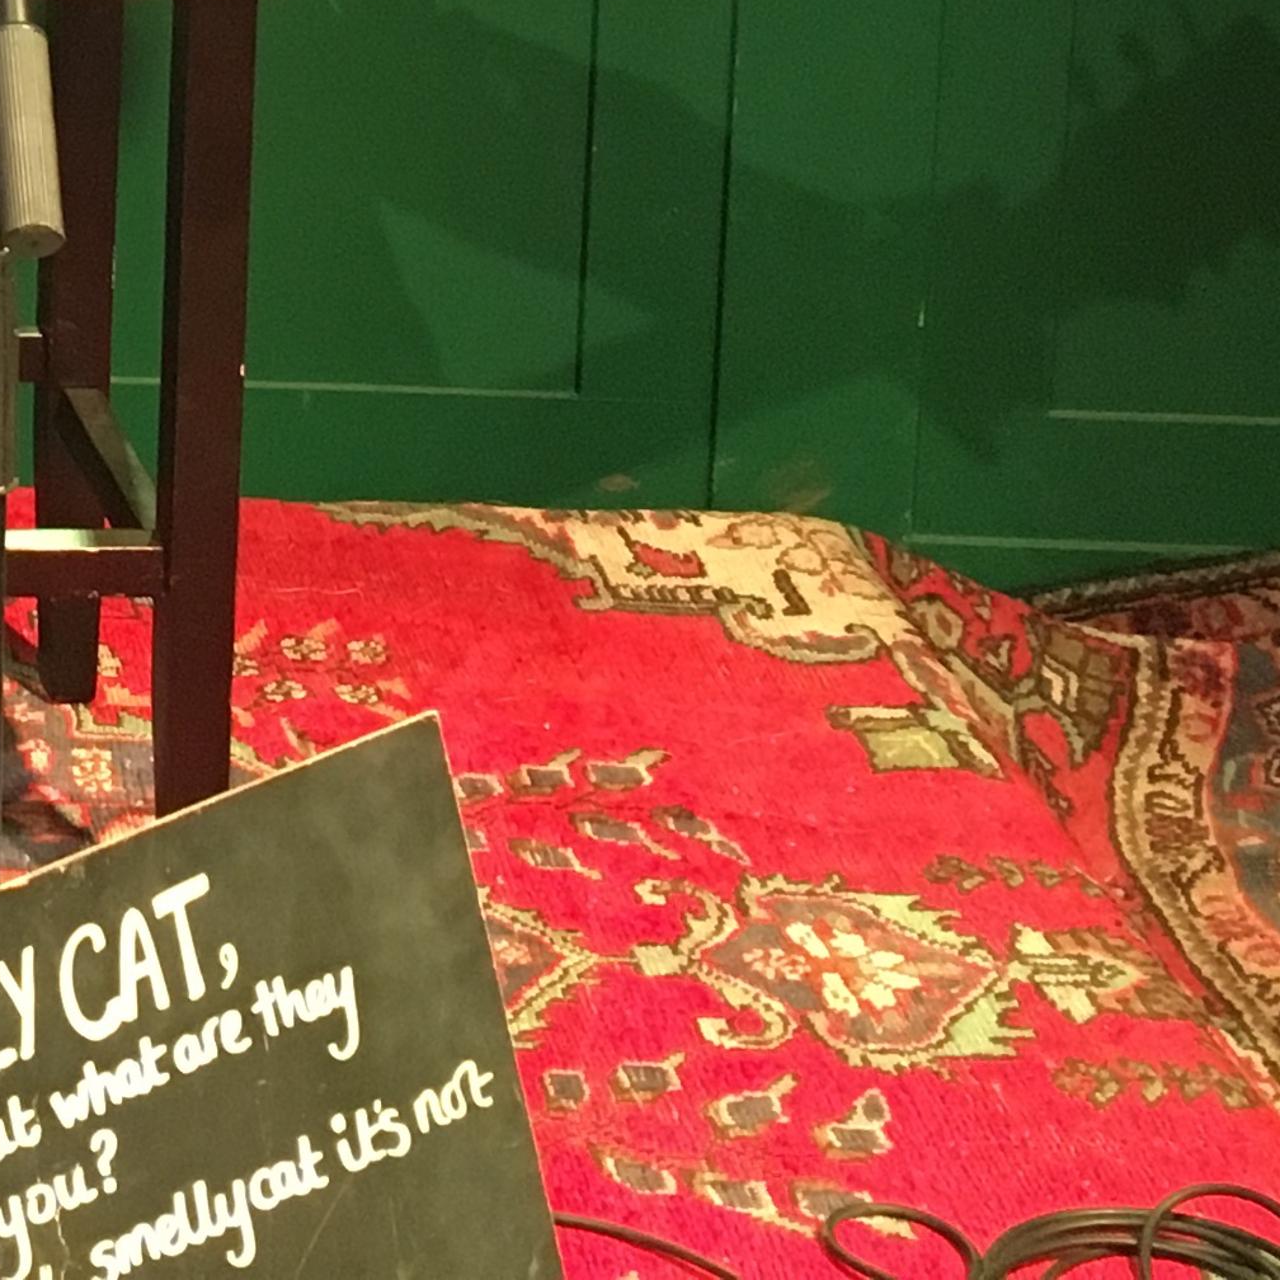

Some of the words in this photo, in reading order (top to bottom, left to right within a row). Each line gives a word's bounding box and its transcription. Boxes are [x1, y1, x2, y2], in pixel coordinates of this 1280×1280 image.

[59, 873, 239, 1042] CAT,
[49, 1036, 170, 1129] what
[173, 1009, 252, 1074] are
[251, 965, 360, 1061] they
[90, 1178, 257, 1280] smelly
[249, 1135, 330, 1211] cat
[329, 1098, 412, 1173] it's
[412, 1059, 495, 1134] not
